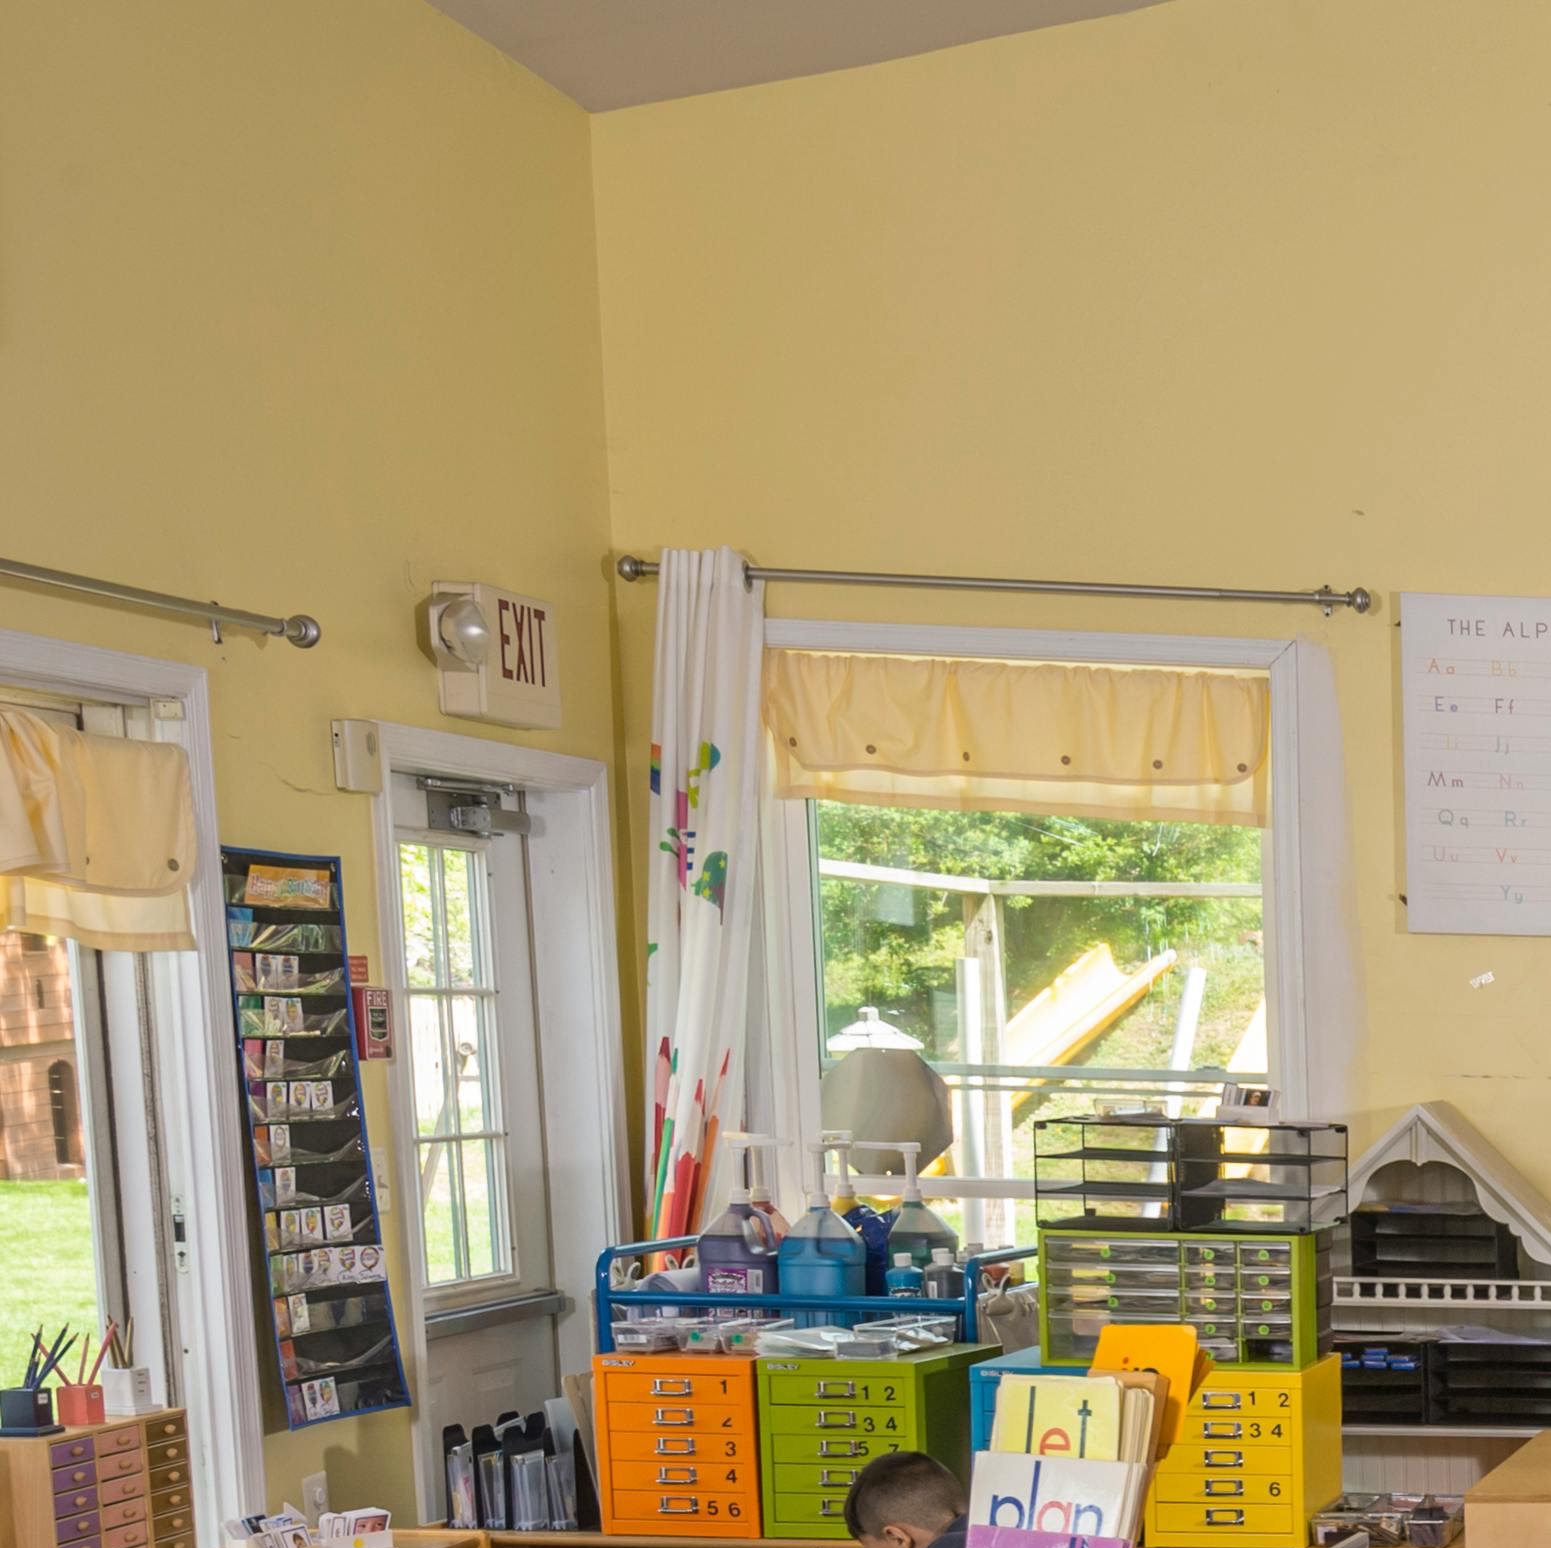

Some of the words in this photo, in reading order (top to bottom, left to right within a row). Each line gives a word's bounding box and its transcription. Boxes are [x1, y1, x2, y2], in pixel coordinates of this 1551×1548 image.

[1447, 617, 1487, 638] THE
[498, 598, 547, 688] EXIT
[366, 990, 388, 1007] FIRE
[719, 1379, 729, 1395] 1
[861, 1385, 870, 1400] 1
[883, 1385, 897, 1402] 2
[1248, 1391, 1257, 1406] 1
[1277, 1393, 1291, 1409] 2
[863, 1416, 876, 1433] 3
[885, 1416, 898, 1432] 4
[1025, 1386, 1093, 1459] let
[1249, 1422, 1262, 1439] 3
[1270, 1423, 1284, 1439] 4
[724, 1440, 737, 1457] 3
[857, 1440, 870, 1456] 5
[725, 1468, 738, 1484] 4
[1268, 1481, 1282, 1498] 6
[989, 1460, 1104, 1538] plan
[706, 1500, 719, 1516] 5
[727, 1501, 742, 1518] 6
